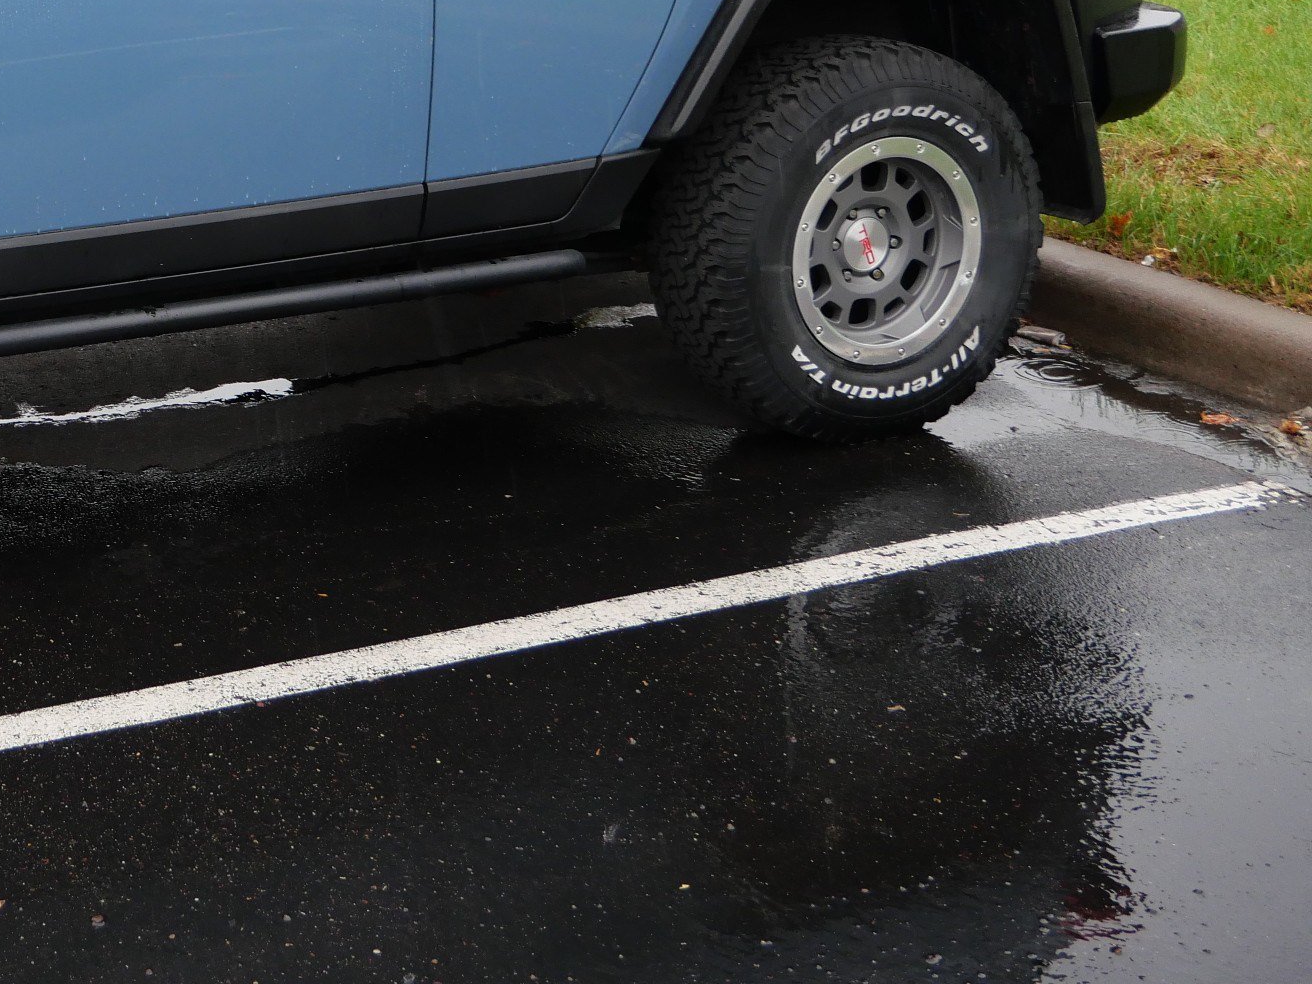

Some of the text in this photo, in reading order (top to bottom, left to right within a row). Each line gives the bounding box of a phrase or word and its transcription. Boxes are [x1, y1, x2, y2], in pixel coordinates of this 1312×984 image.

[815, 104, 989, 165] BFGoodrich
[858, 223, 875, 265] TRD
[791, 325, 981, 400] All-Terrain T/A
